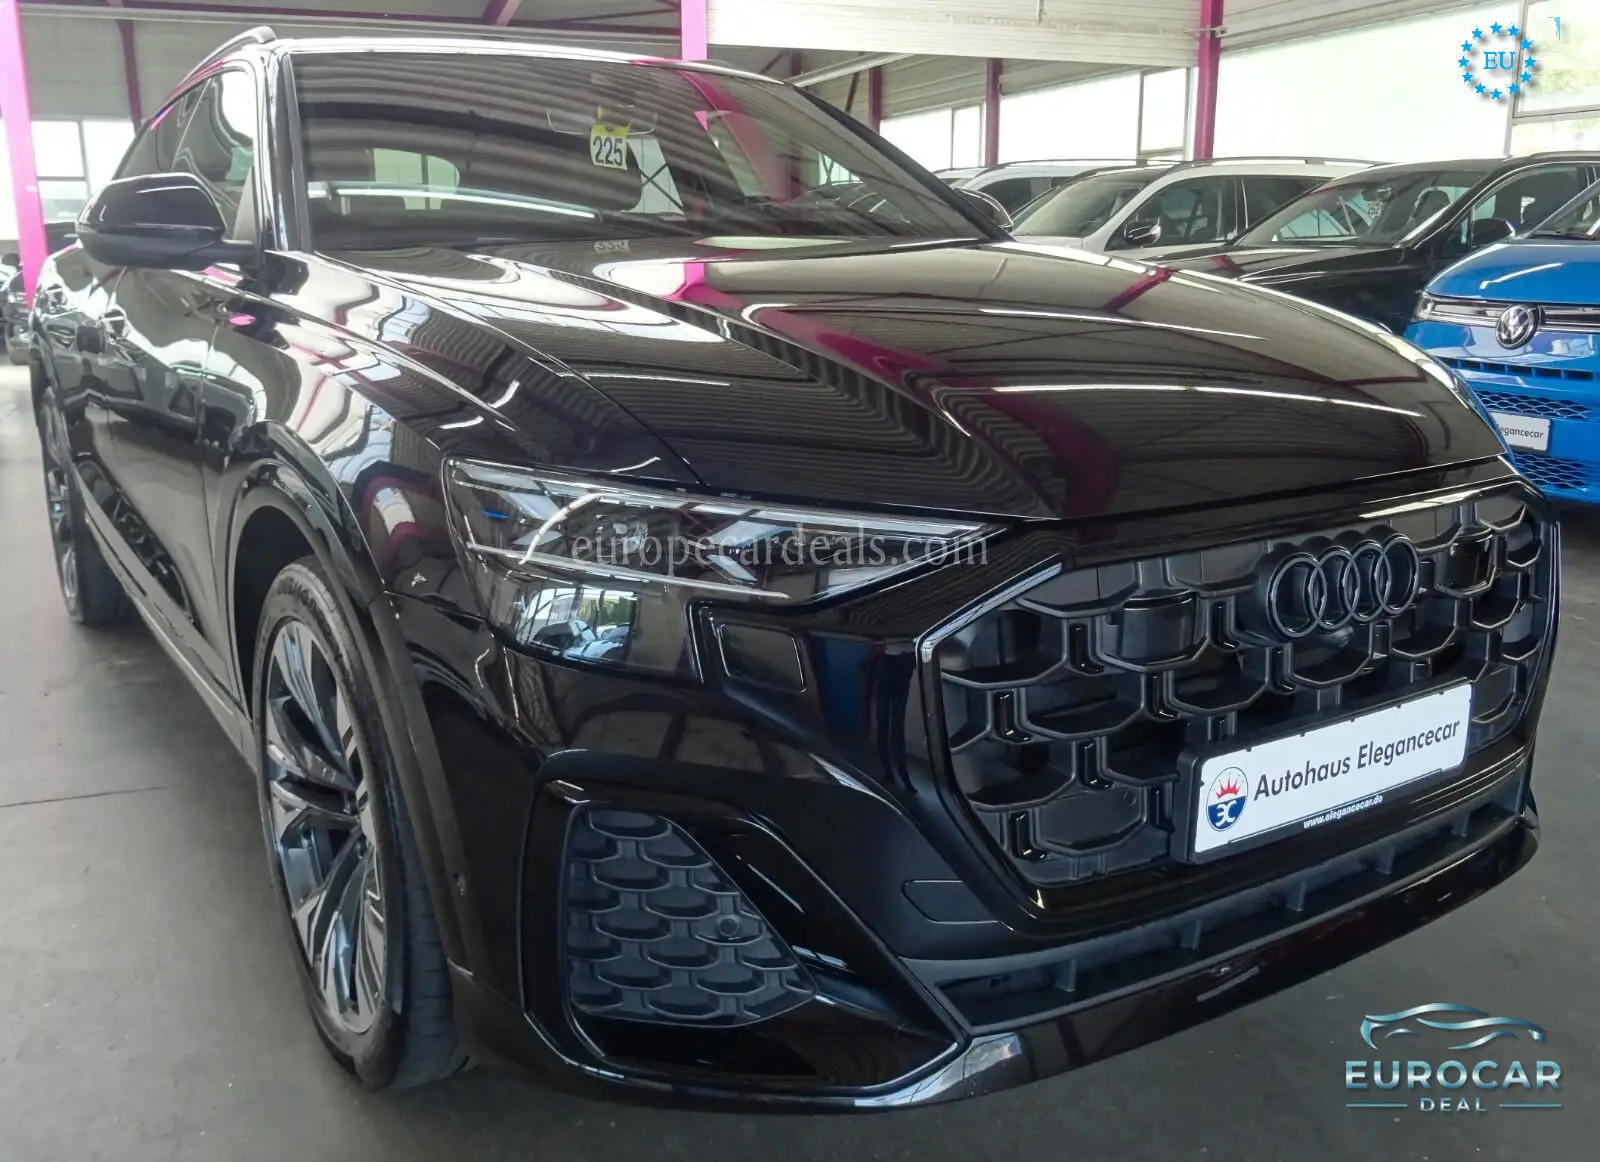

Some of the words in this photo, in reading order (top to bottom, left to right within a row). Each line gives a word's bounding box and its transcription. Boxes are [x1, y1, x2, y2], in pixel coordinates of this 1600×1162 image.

[592, 135, 625, 167] 225
[1253, 755, 1351, 802] Autohaus
[1356, 719, 1461, 769] Elegancecar
[1303, 794, 1384, 829] www.elegancecar.de
